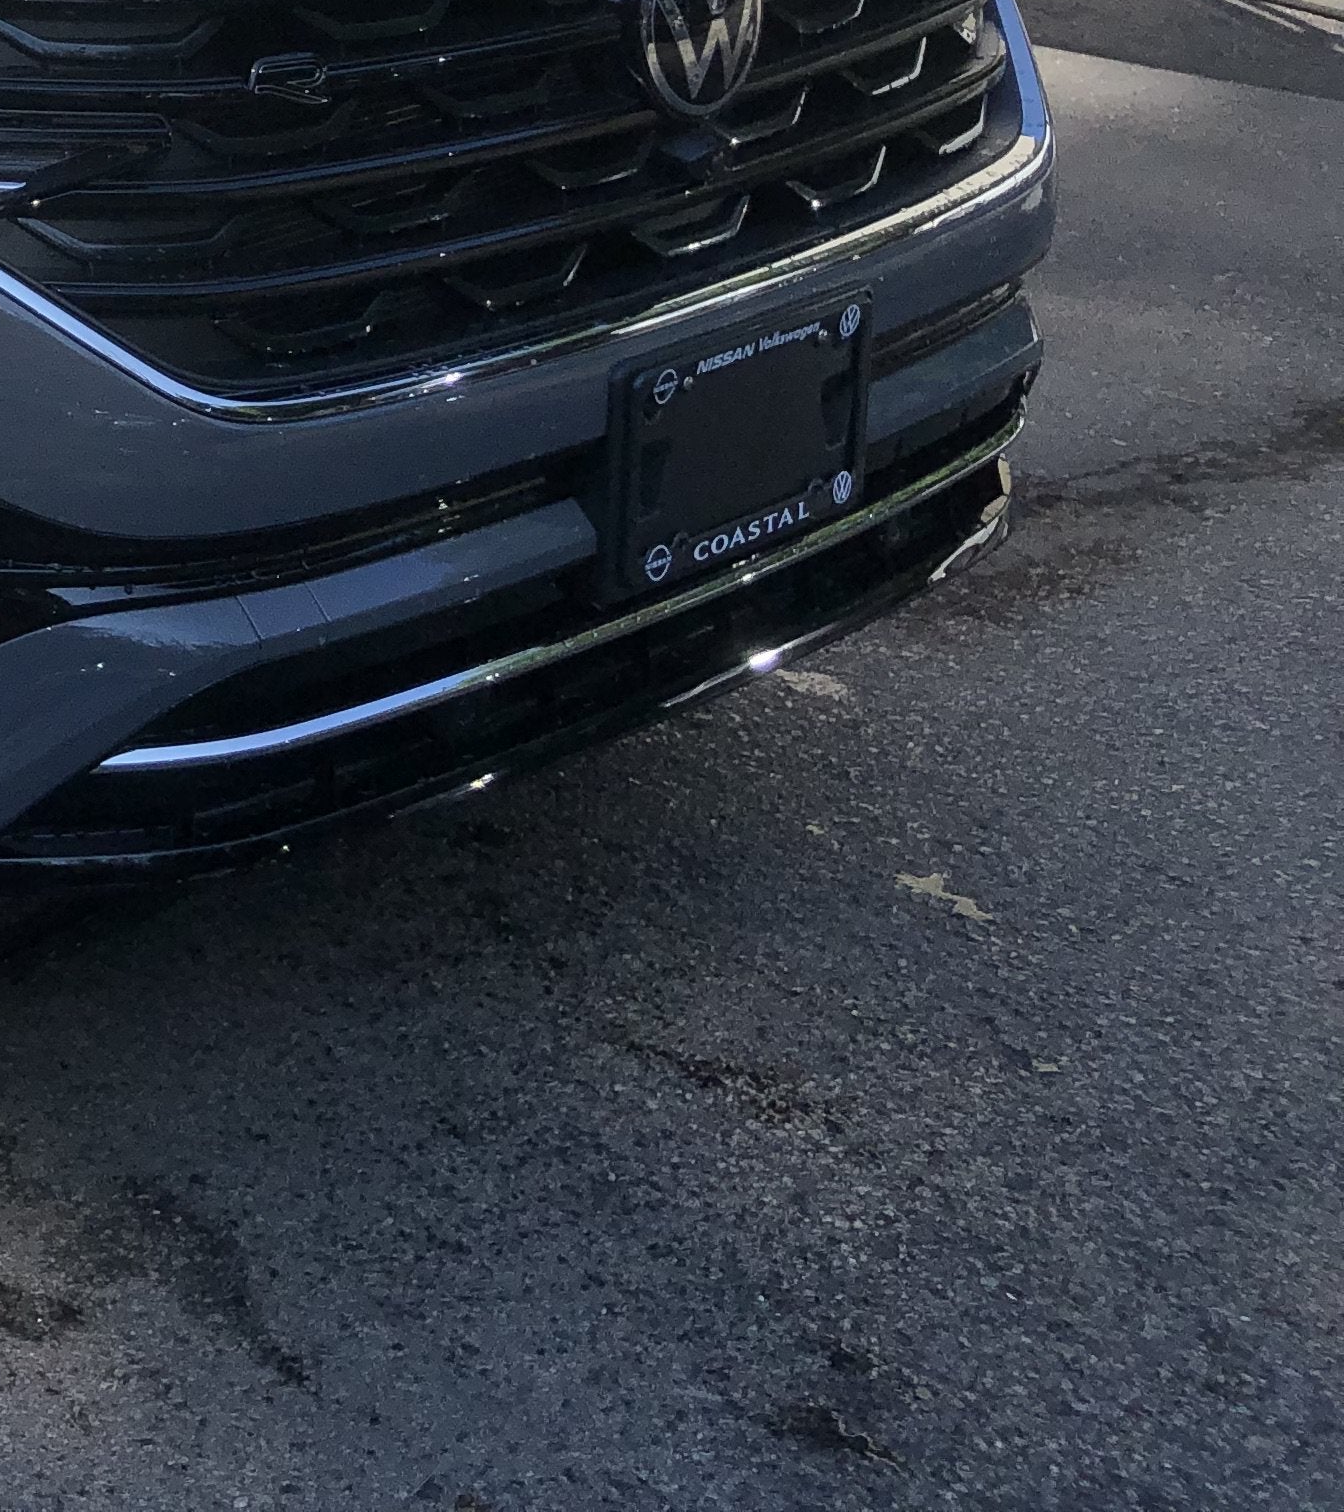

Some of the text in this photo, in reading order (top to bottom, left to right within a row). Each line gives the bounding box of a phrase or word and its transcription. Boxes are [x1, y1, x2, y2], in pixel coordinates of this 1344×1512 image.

[696, 321, 821, 375] NISSAN Volkswagen
[693, 501, 810, 562] COASTAL
